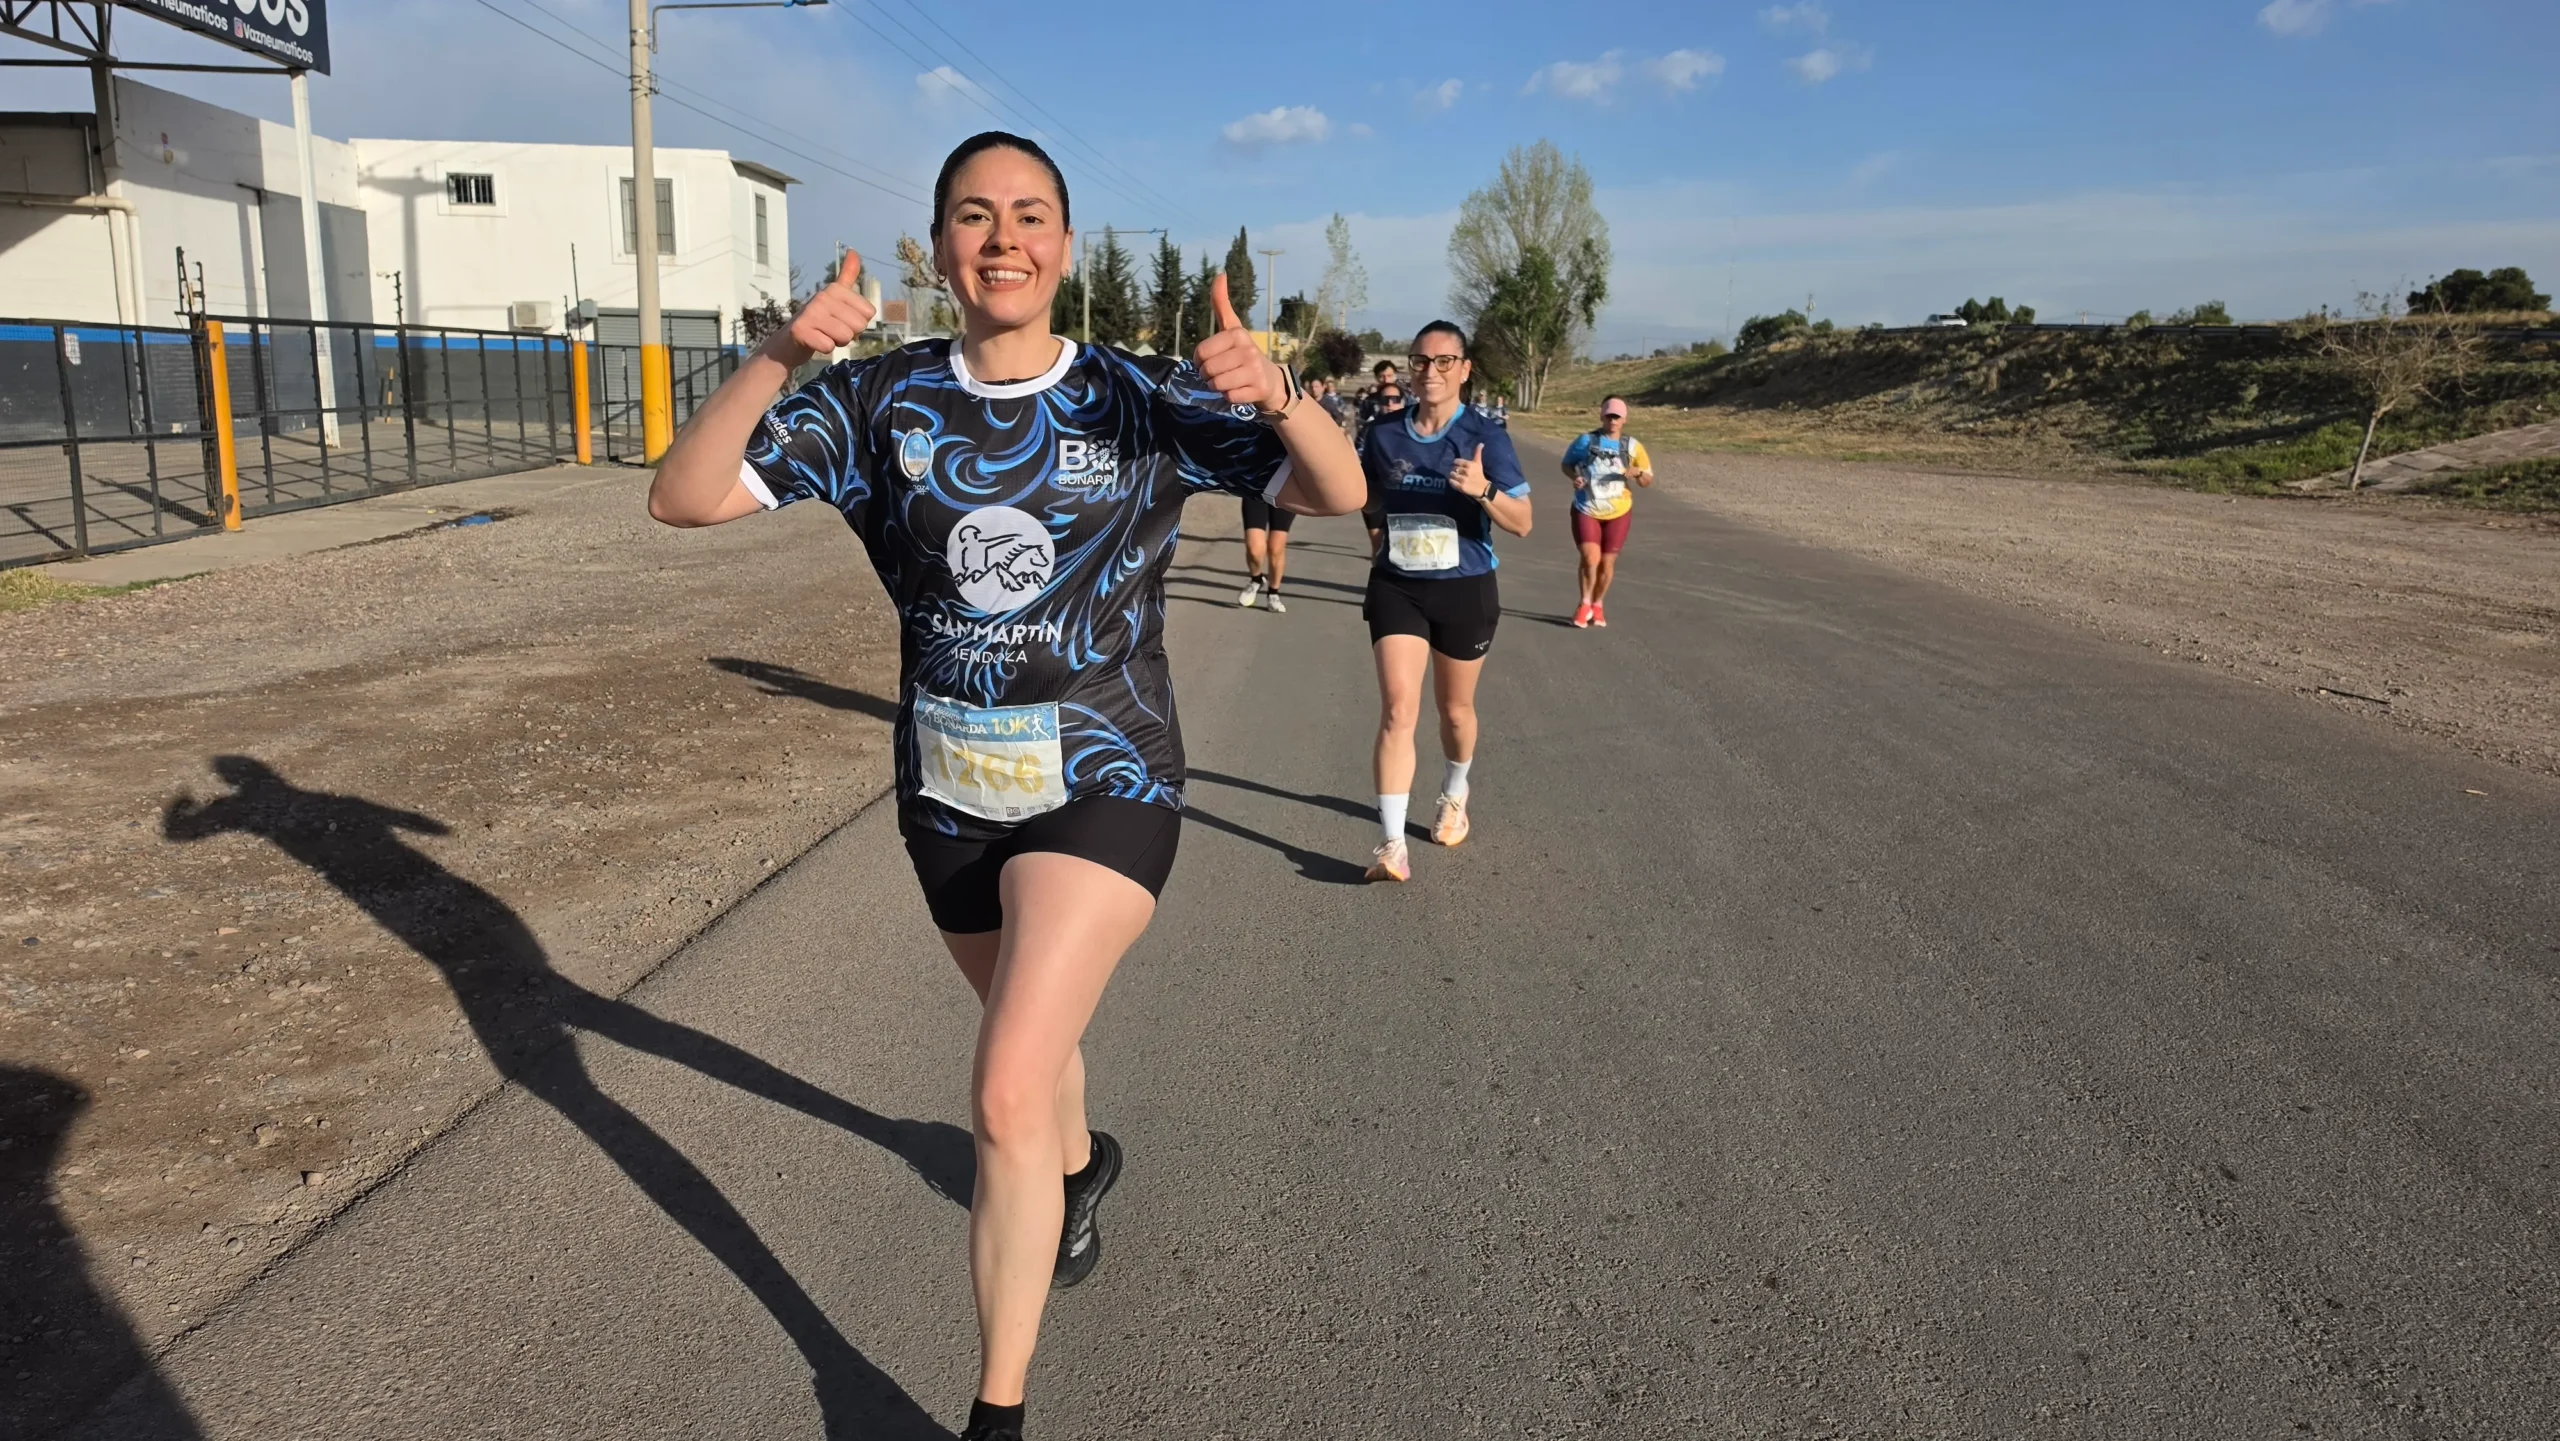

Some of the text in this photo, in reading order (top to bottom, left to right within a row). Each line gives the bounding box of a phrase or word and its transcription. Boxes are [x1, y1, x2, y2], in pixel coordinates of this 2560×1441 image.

[932, 613, 972, 640] SAN
[947, 647, 1028, 664] MENDOZA
[991, 715, 1031, 736] 10K
[930, 743, 1045, 794] 1266
